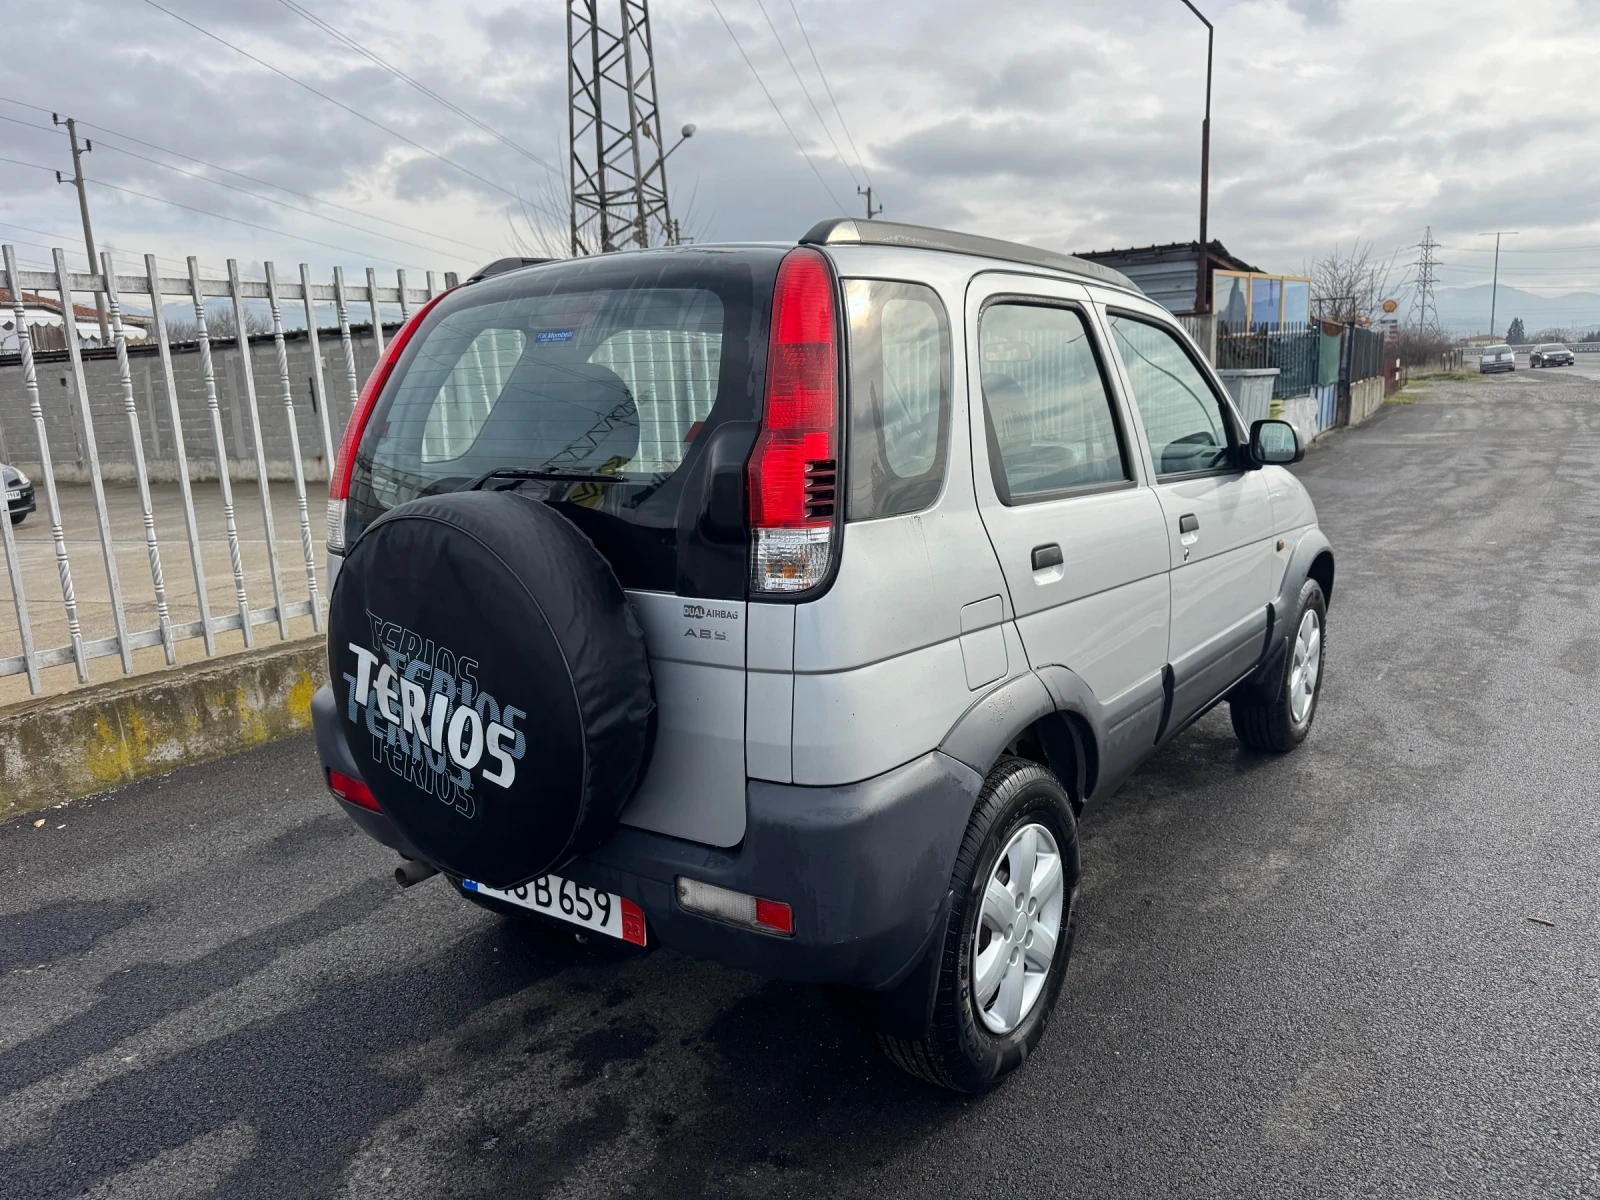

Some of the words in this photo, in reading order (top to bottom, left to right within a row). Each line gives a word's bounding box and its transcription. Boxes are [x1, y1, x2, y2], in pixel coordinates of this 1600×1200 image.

[684, 605, 705, 619] DUAL
[706, 609, 738, 619] AIRBAG
[349, 642, 516, 789] TERIOS
